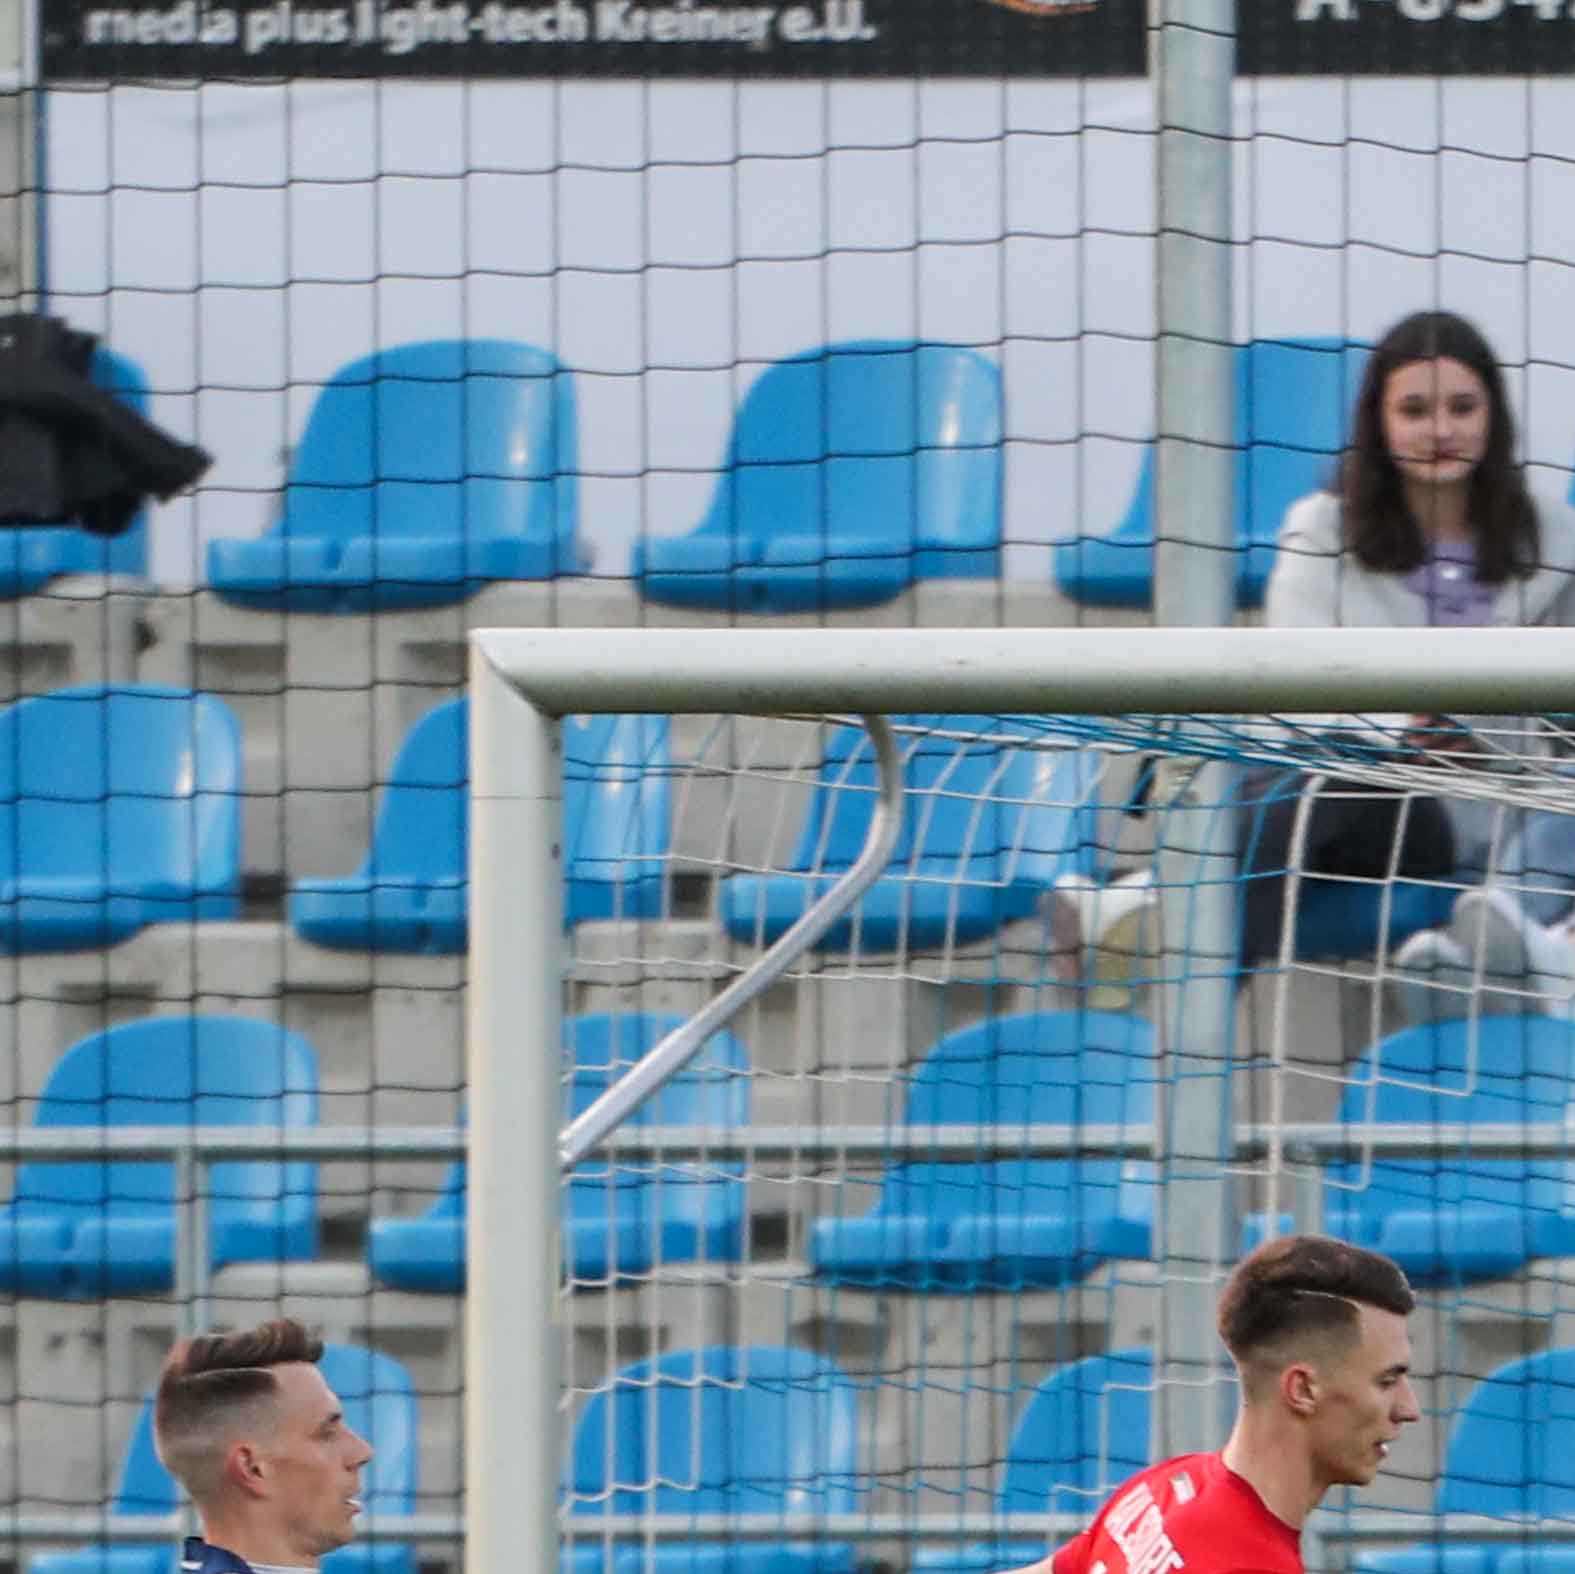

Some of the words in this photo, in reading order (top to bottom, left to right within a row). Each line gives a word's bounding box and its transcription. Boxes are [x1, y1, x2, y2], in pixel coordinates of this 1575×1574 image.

[86, 0, 238, 44] media
[243, 0, 349, 54] plus
[352, 0, 588, 54] light-tech
[596, 0, 776, 44] Kreiner
[779, 0, 879, 42] e.U.
